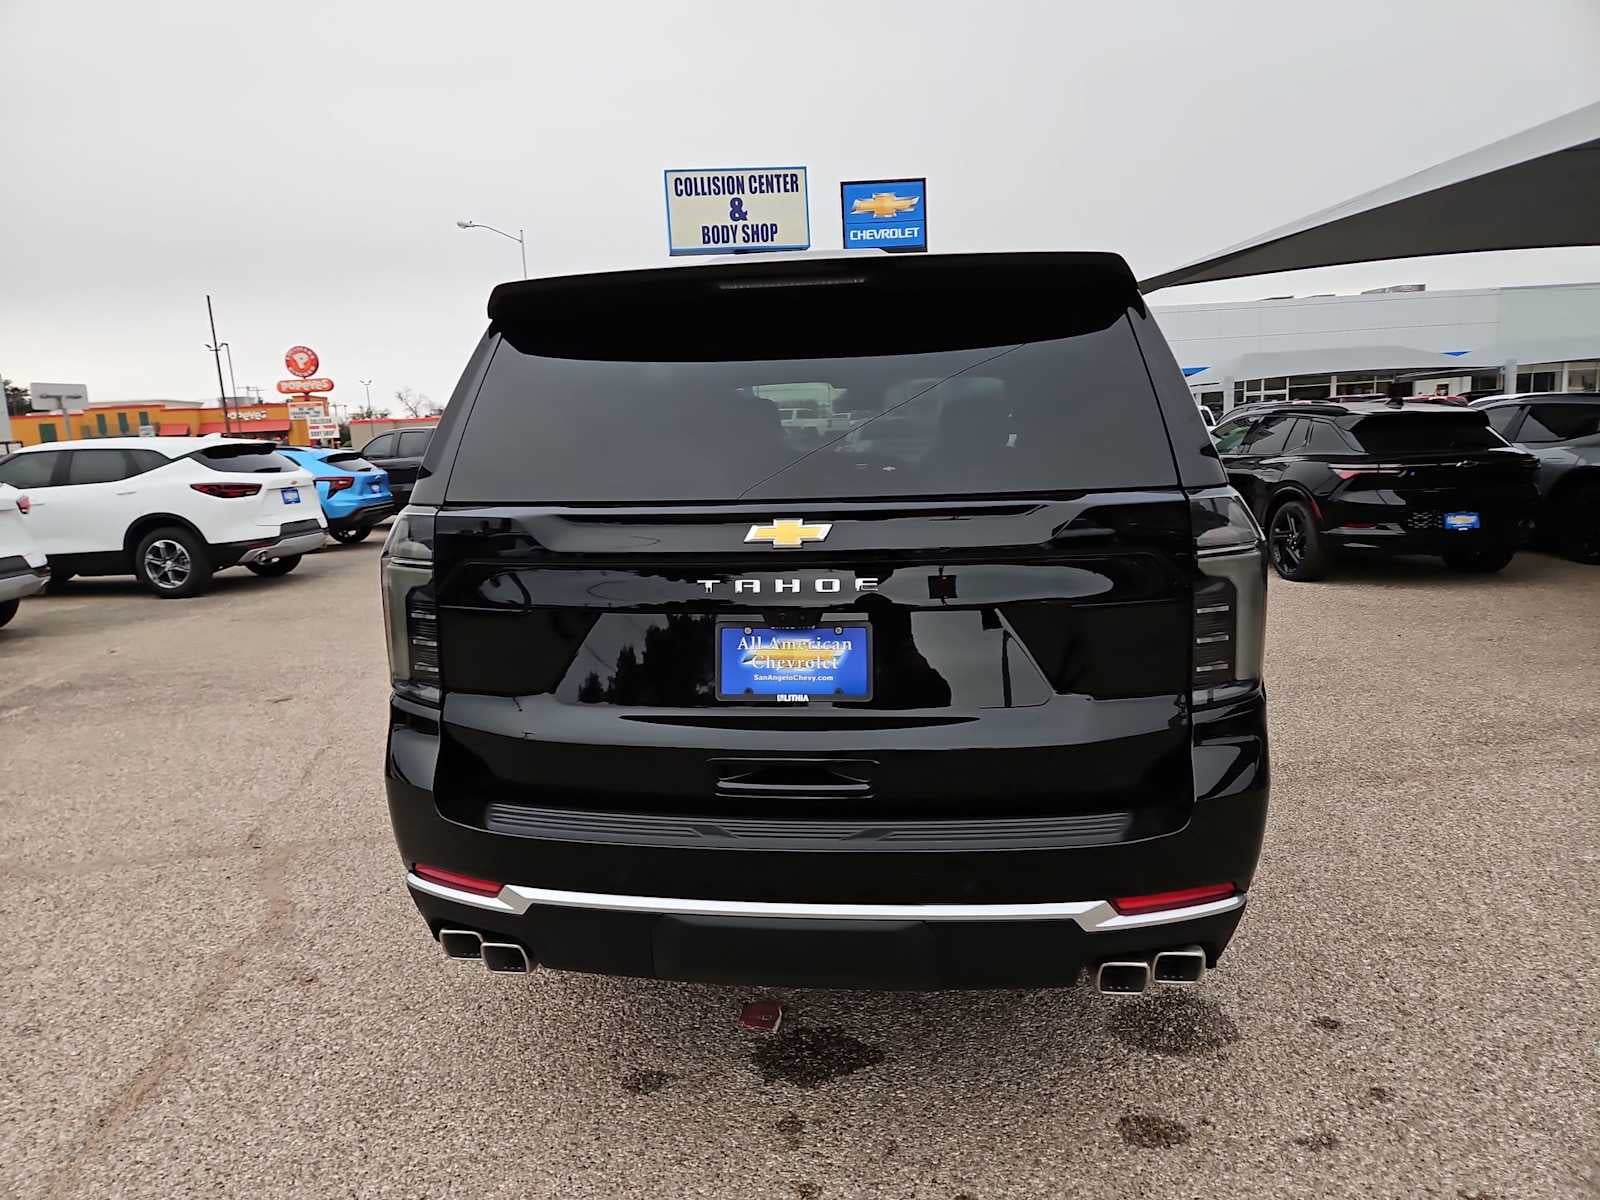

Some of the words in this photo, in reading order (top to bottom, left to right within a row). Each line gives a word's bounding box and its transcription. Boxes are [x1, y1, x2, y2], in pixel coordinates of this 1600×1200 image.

[674, 175, 745, 197] COLLISION
[749, 173, 799, 194] CENTER
[729, 197, 748, 222] &
[702, 224, 738, 245] BODY
[739, 223, 778, 244] SHOP
[849, 227, 920, 241] CHEVROLET
[697, 578, 879, 593] TAHOE
[737, 636, 762, 650] All
[769, 636, 852, 651] American
[752, 655, 838, 671] Chevrolet
[753, 674, 834, 682] SanAngeloChevy.com
